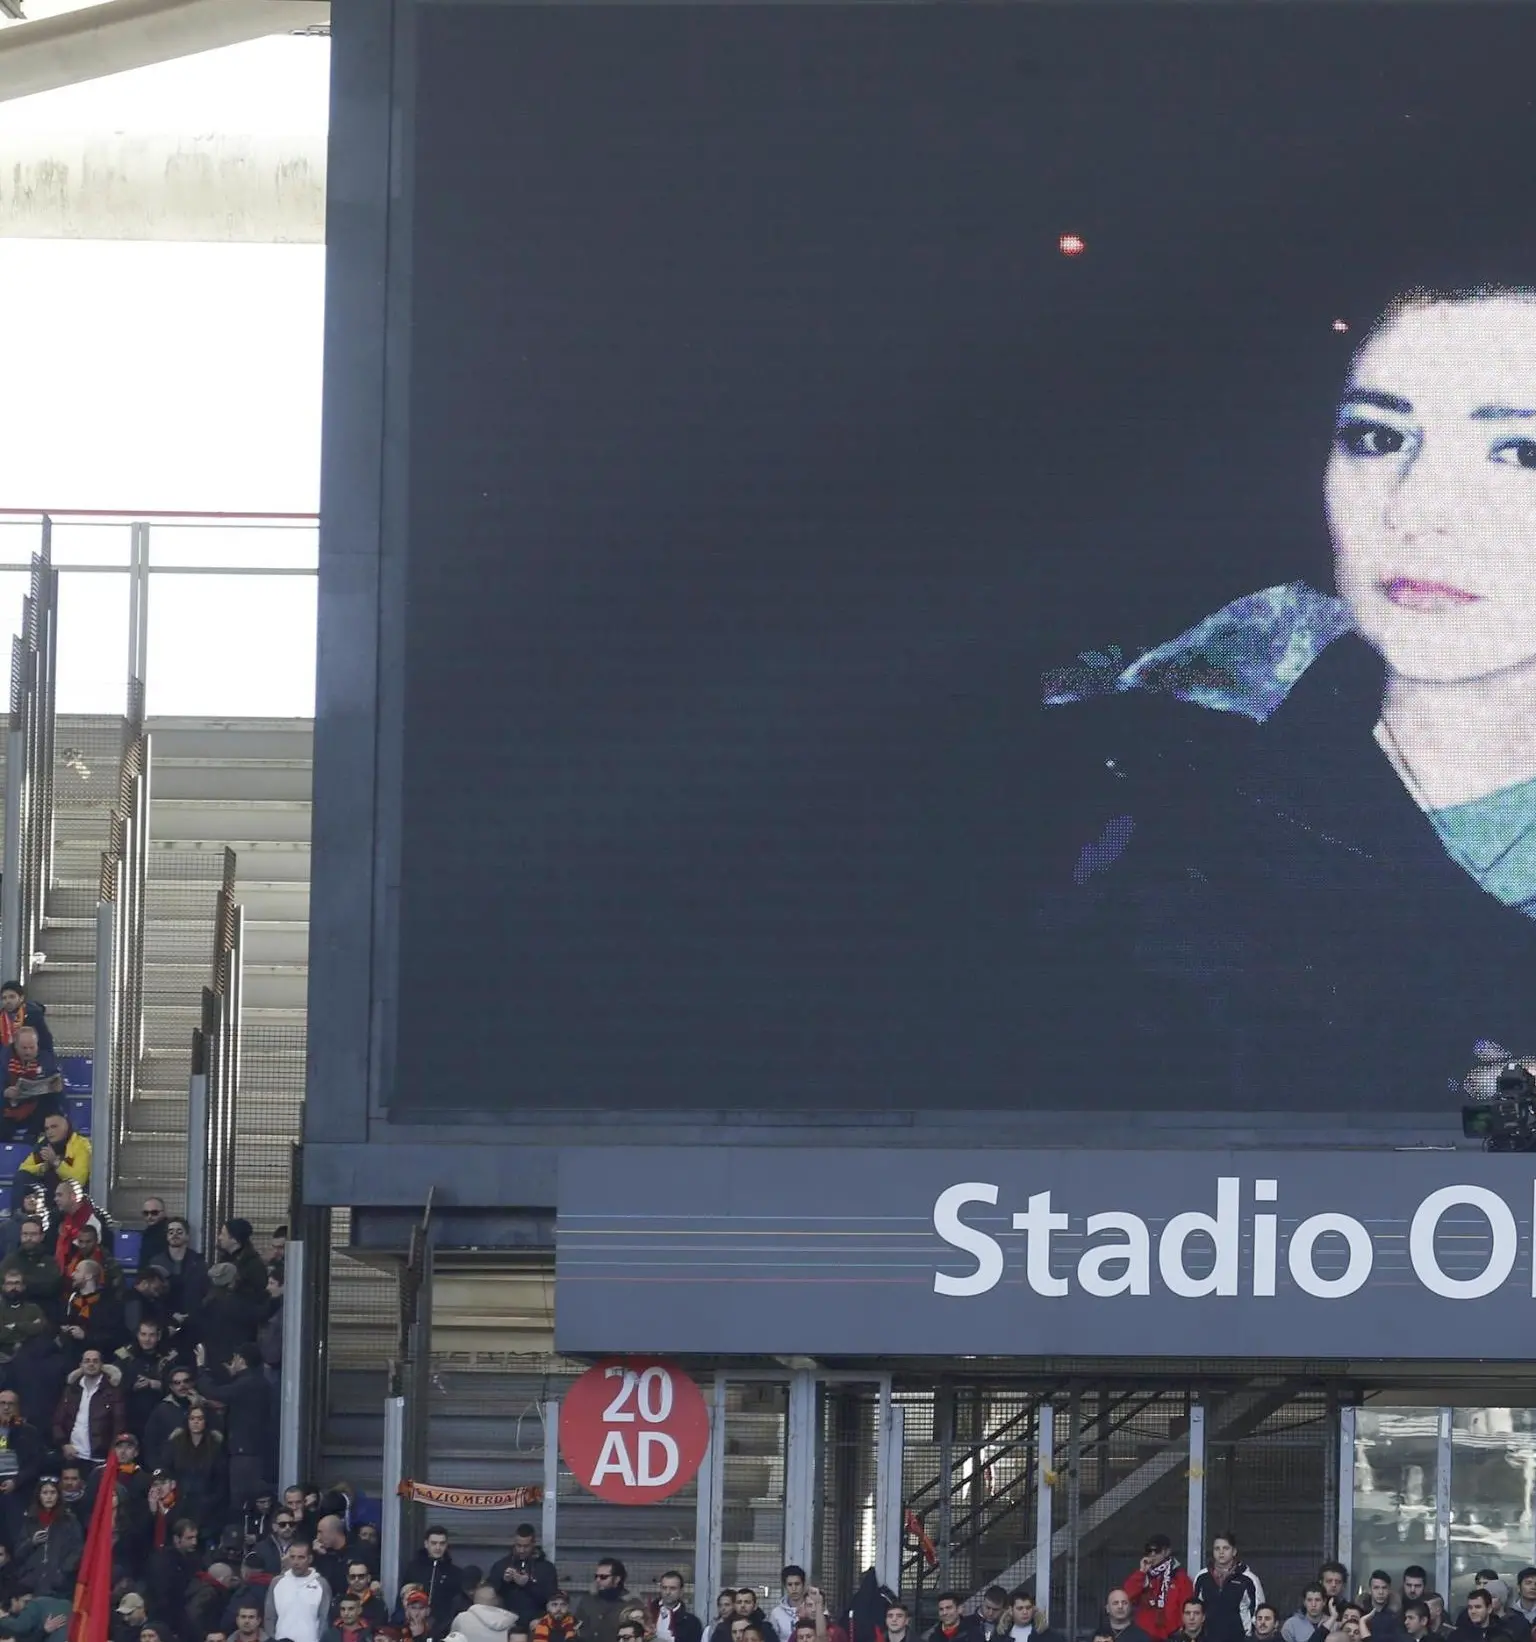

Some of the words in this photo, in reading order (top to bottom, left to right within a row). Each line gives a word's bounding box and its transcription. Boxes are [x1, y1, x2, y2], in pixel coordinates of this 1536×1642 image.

[933, 1177, 1374, 1299] Stadio
[602, 1366, 673, 1423] 20
[589, 1430, 680, 1488] AD
[462, 1493, 514, 1505] MERDA
